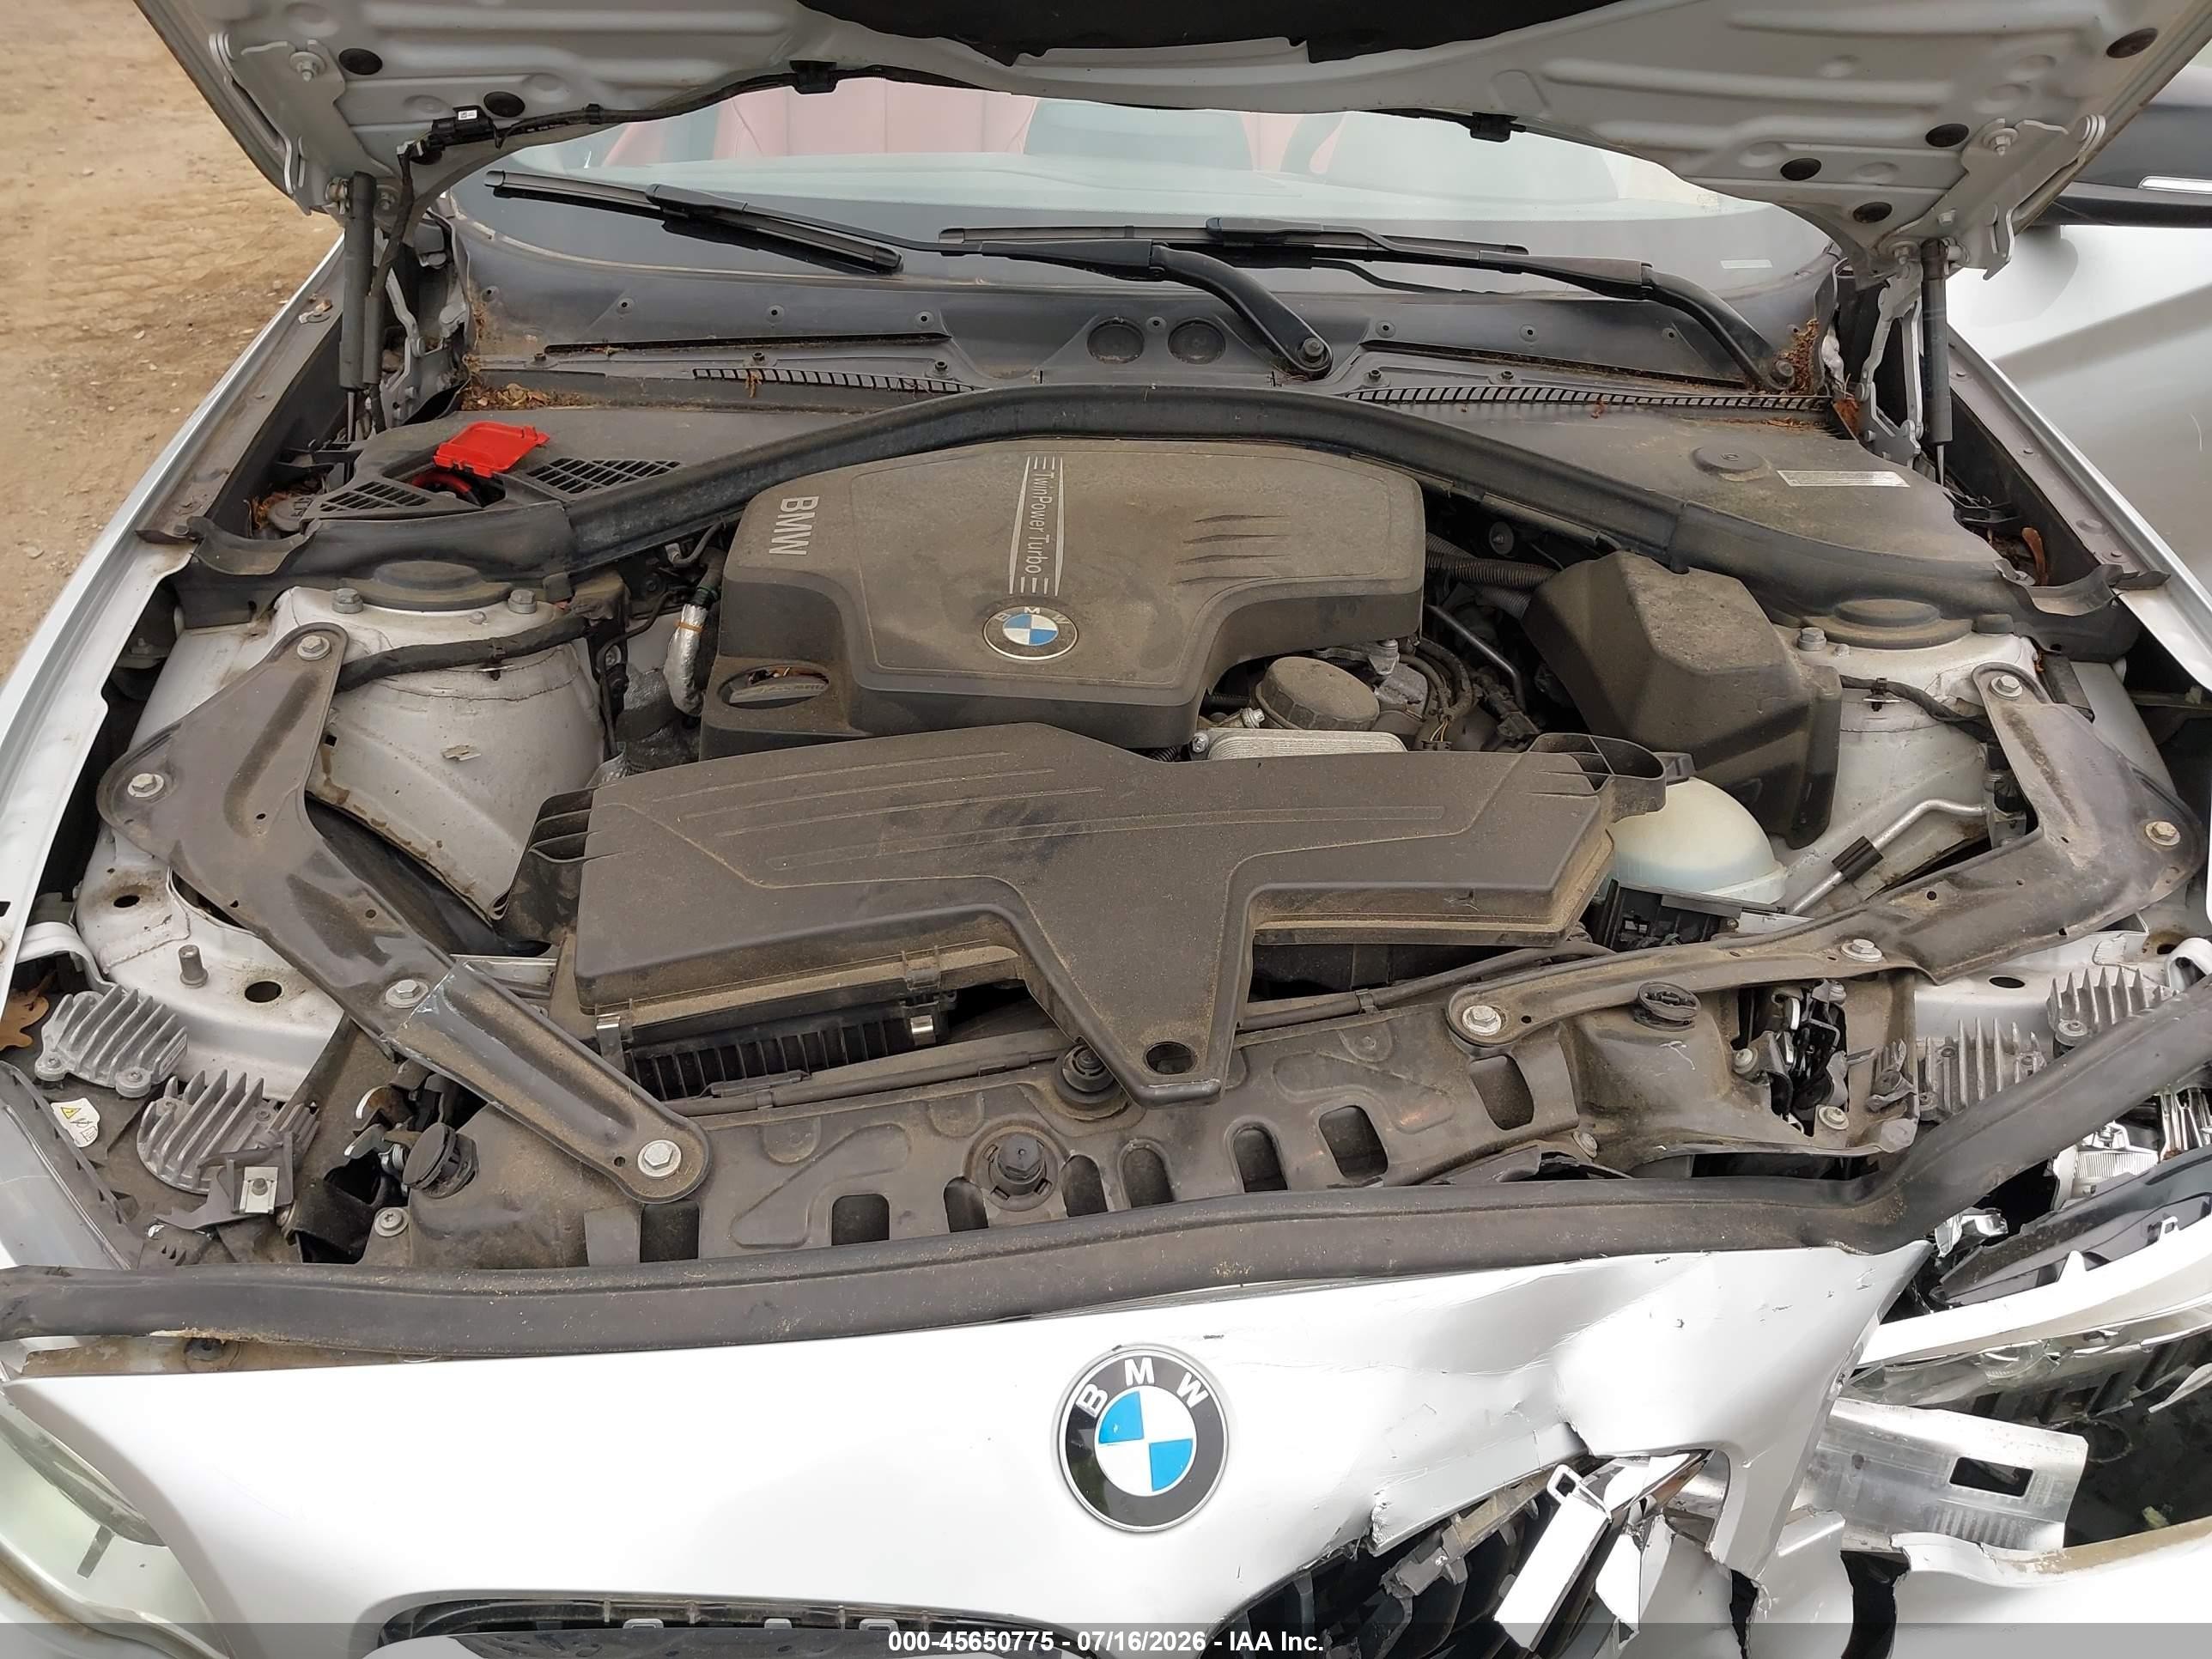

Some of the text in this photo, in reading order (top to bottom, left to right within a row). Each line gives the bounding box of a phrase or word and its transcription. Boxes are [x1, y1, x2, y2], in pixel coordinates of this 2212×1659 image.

[769, 495, 820, 556] BMW
[1024, 471, 1054, 574] TwinPower Turbo
[994, 606, 1071, 624] BMW
[1075, 1356, 1210, 1418] BMW
